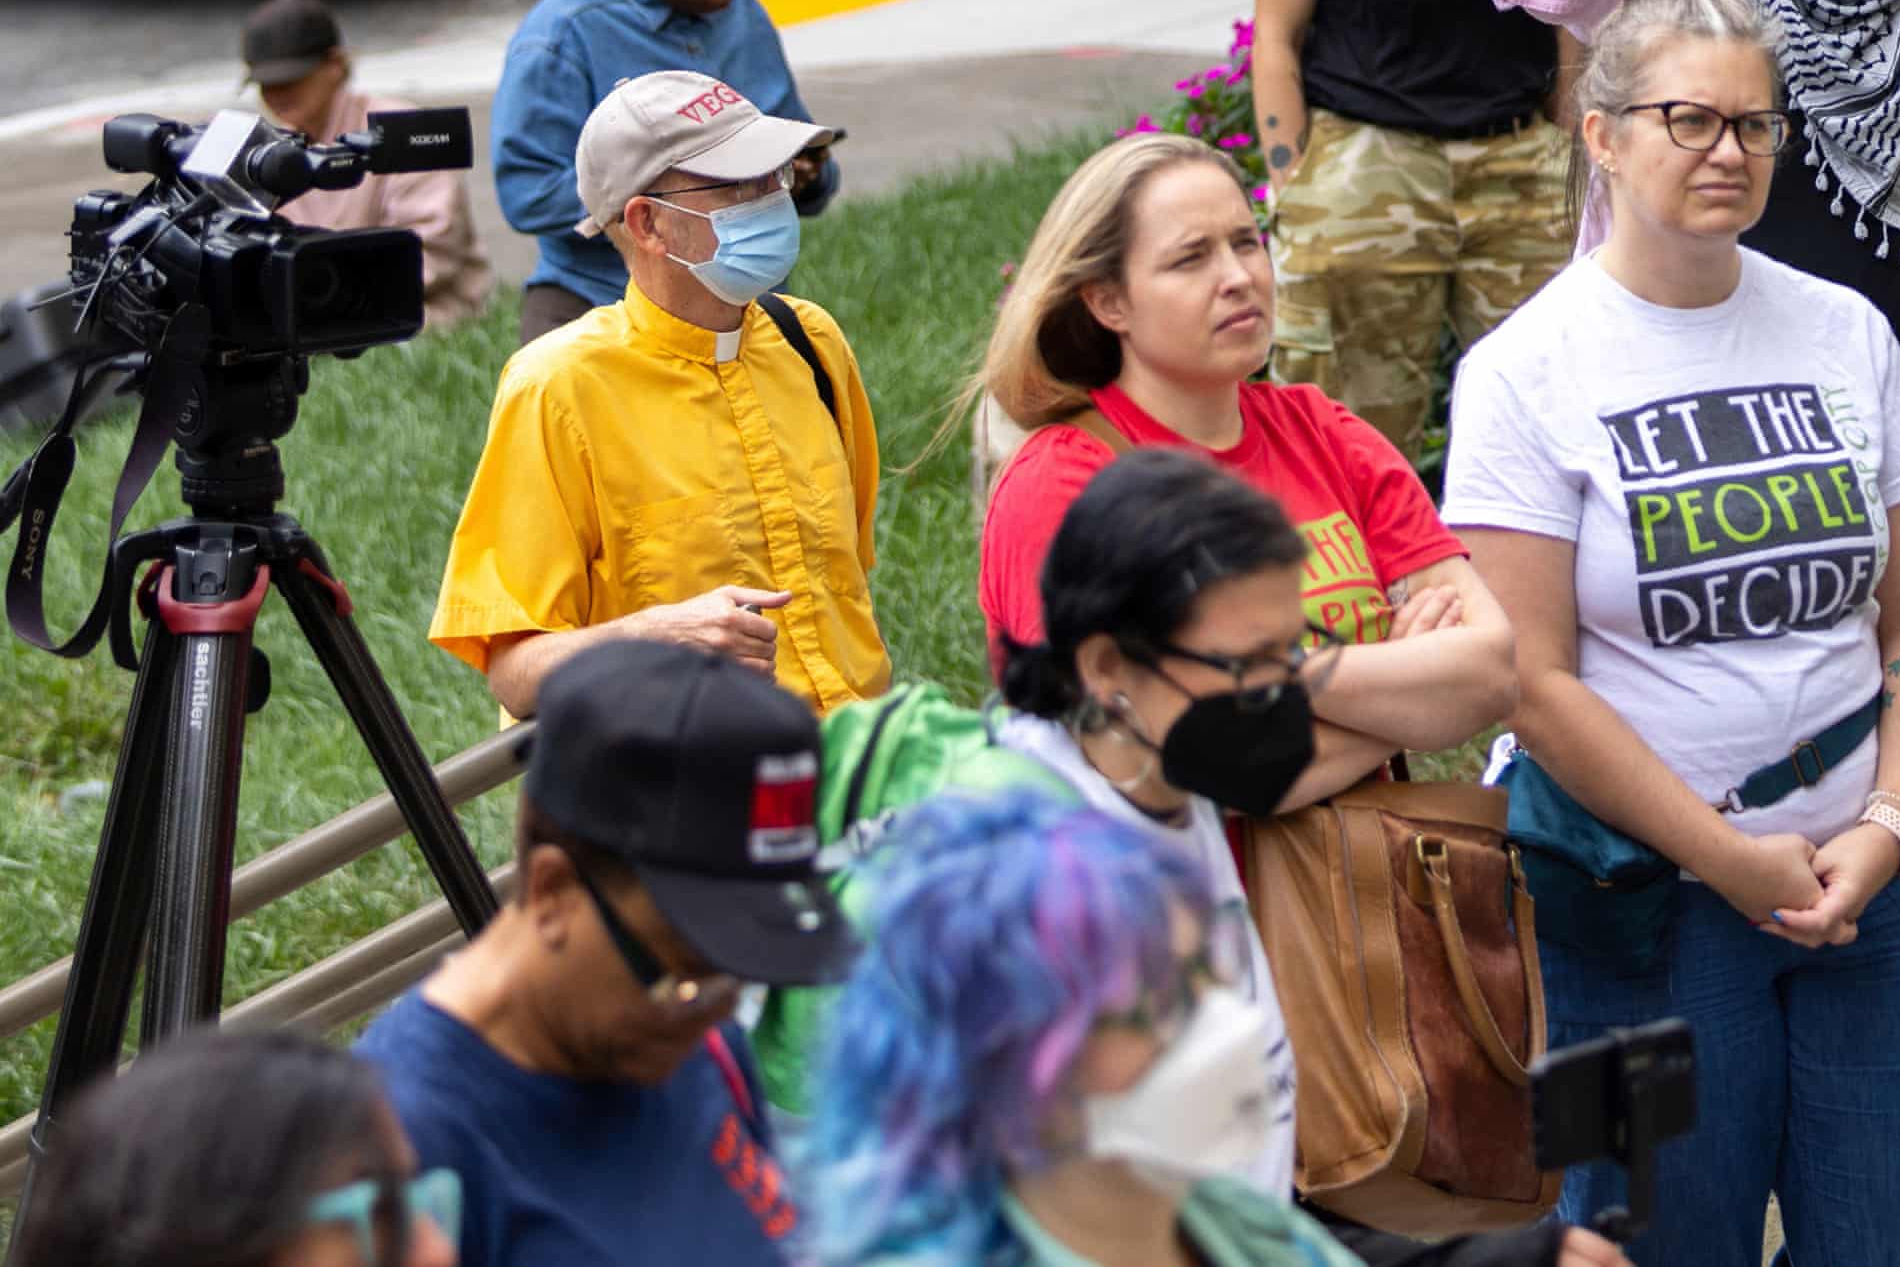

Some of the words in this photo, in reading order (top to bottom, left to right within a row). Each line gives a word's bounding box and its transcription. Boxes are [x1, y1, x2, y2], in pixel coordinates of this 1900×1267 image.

[675, 83, 742, 124] VEG
[1608, 400, 1708, 475] LET
[1727, 390, 1834, 455] THE
[1820, 384, 1868, 451] CITY
[19, 508, 46, 581] SONY
[1636, 465, 1866, 564] PEOPLE
[1650, 555, 1871, 645] DECIDE
[189, 641, 210, 732] sachtler
